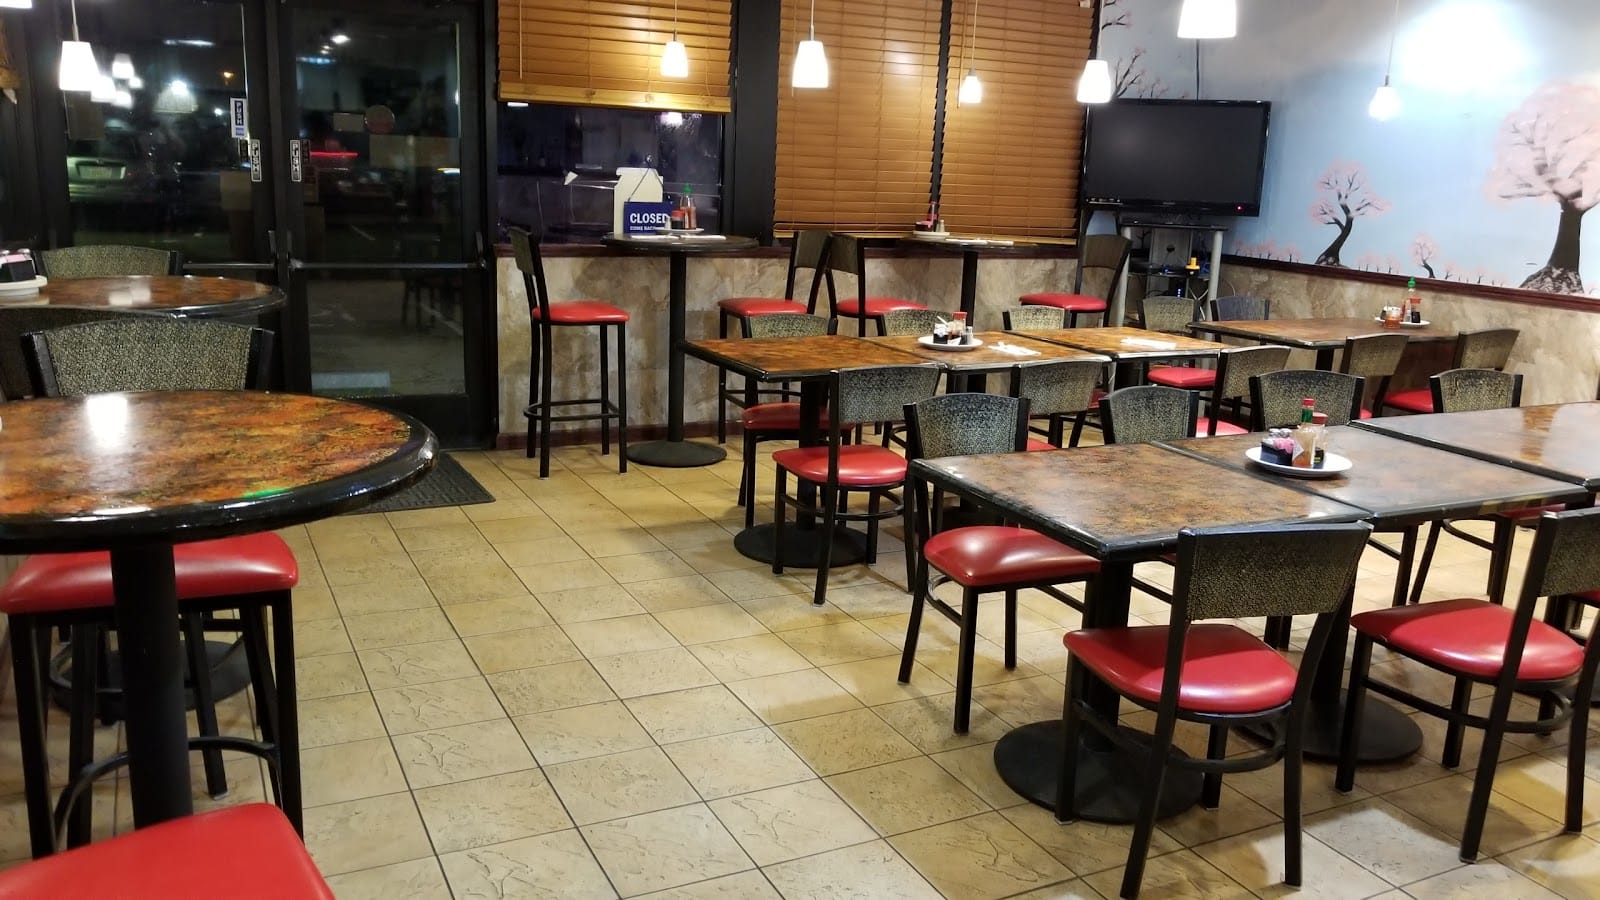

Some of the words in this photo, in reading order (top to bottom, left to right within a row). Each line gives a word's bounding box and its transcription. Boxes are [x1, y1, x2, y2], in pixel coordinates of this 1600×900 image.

[252, 143, 260, 172] PUSH
[292, 143, 300, 172] PUSH
[630, 213, 668, 223] CLOSED
